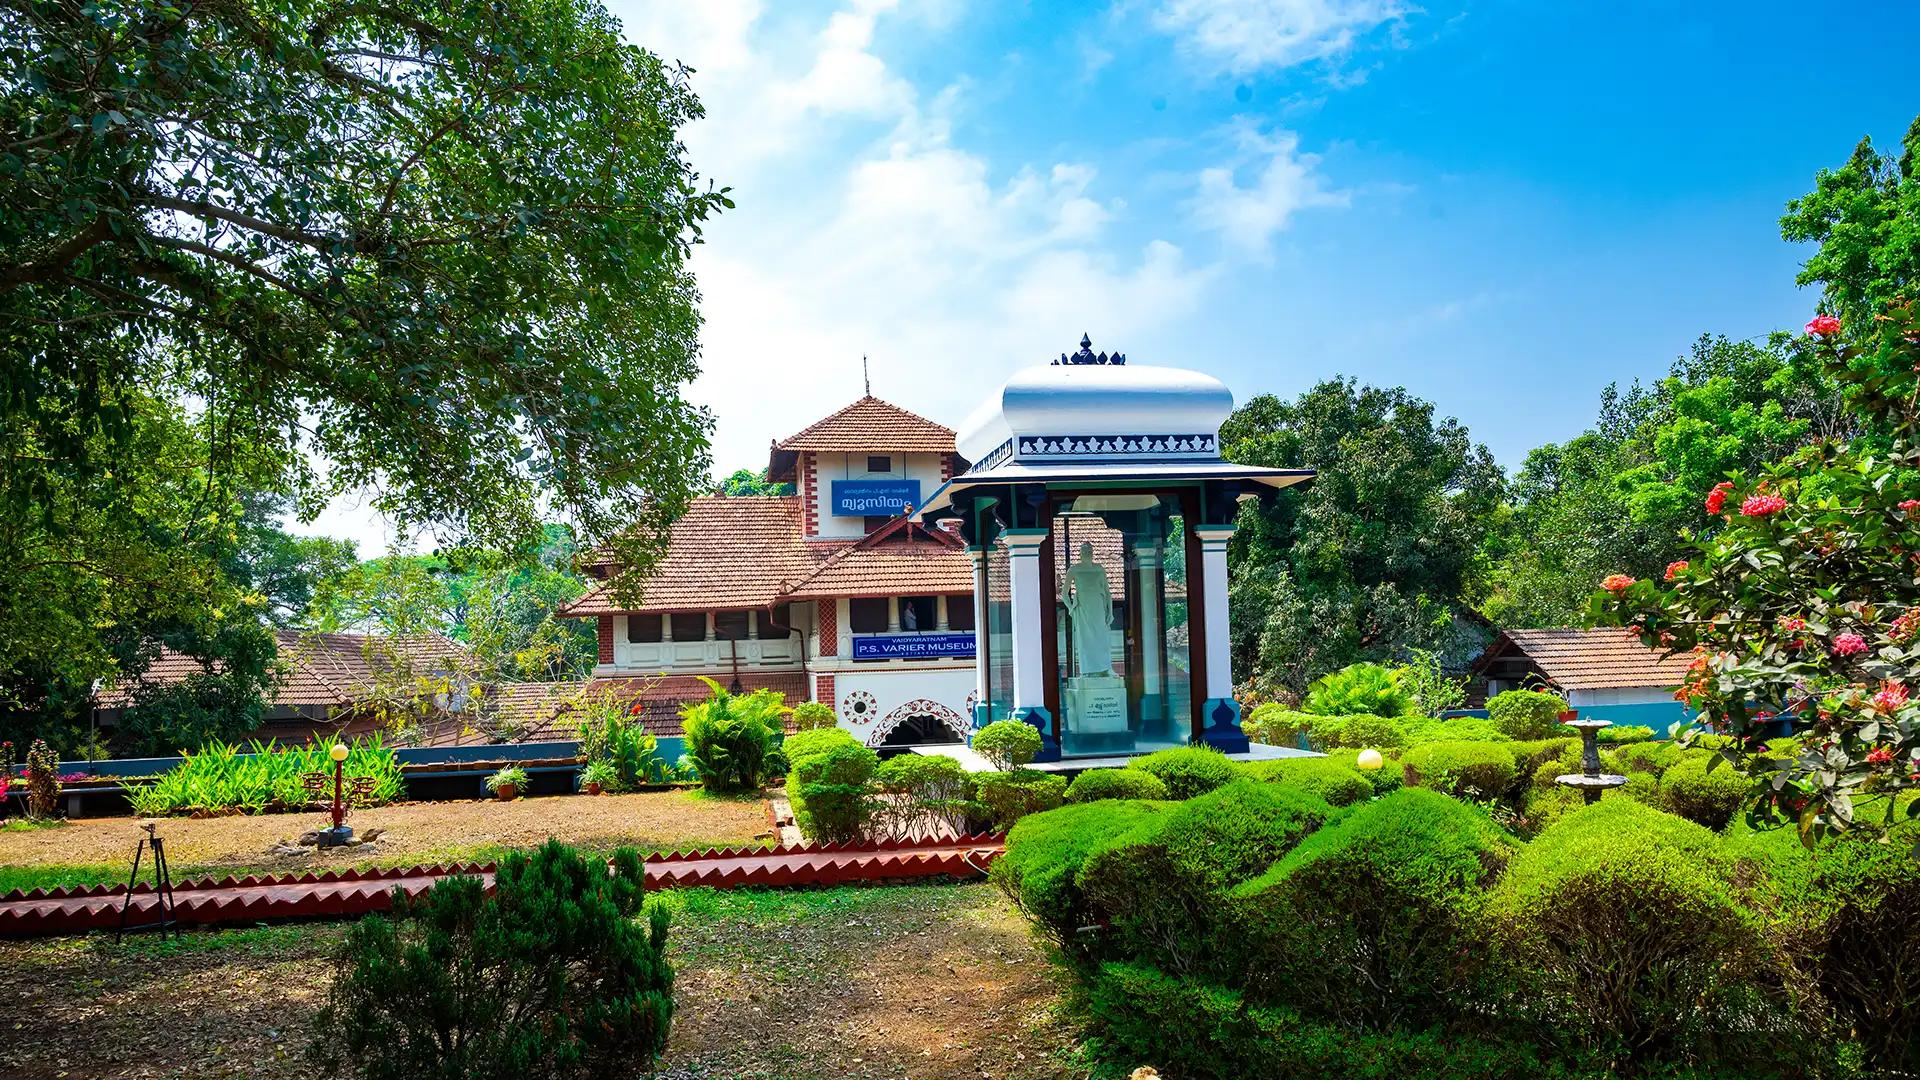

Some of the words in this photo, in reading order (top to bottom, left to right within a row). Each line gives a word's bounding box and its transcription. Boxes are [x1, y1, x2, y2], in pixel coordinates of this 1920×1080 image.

[859, 645, 880, 653] P.S.
[882, 643, 925, 653] VARIER
[928, 642, 976, 651] MUSEUM
